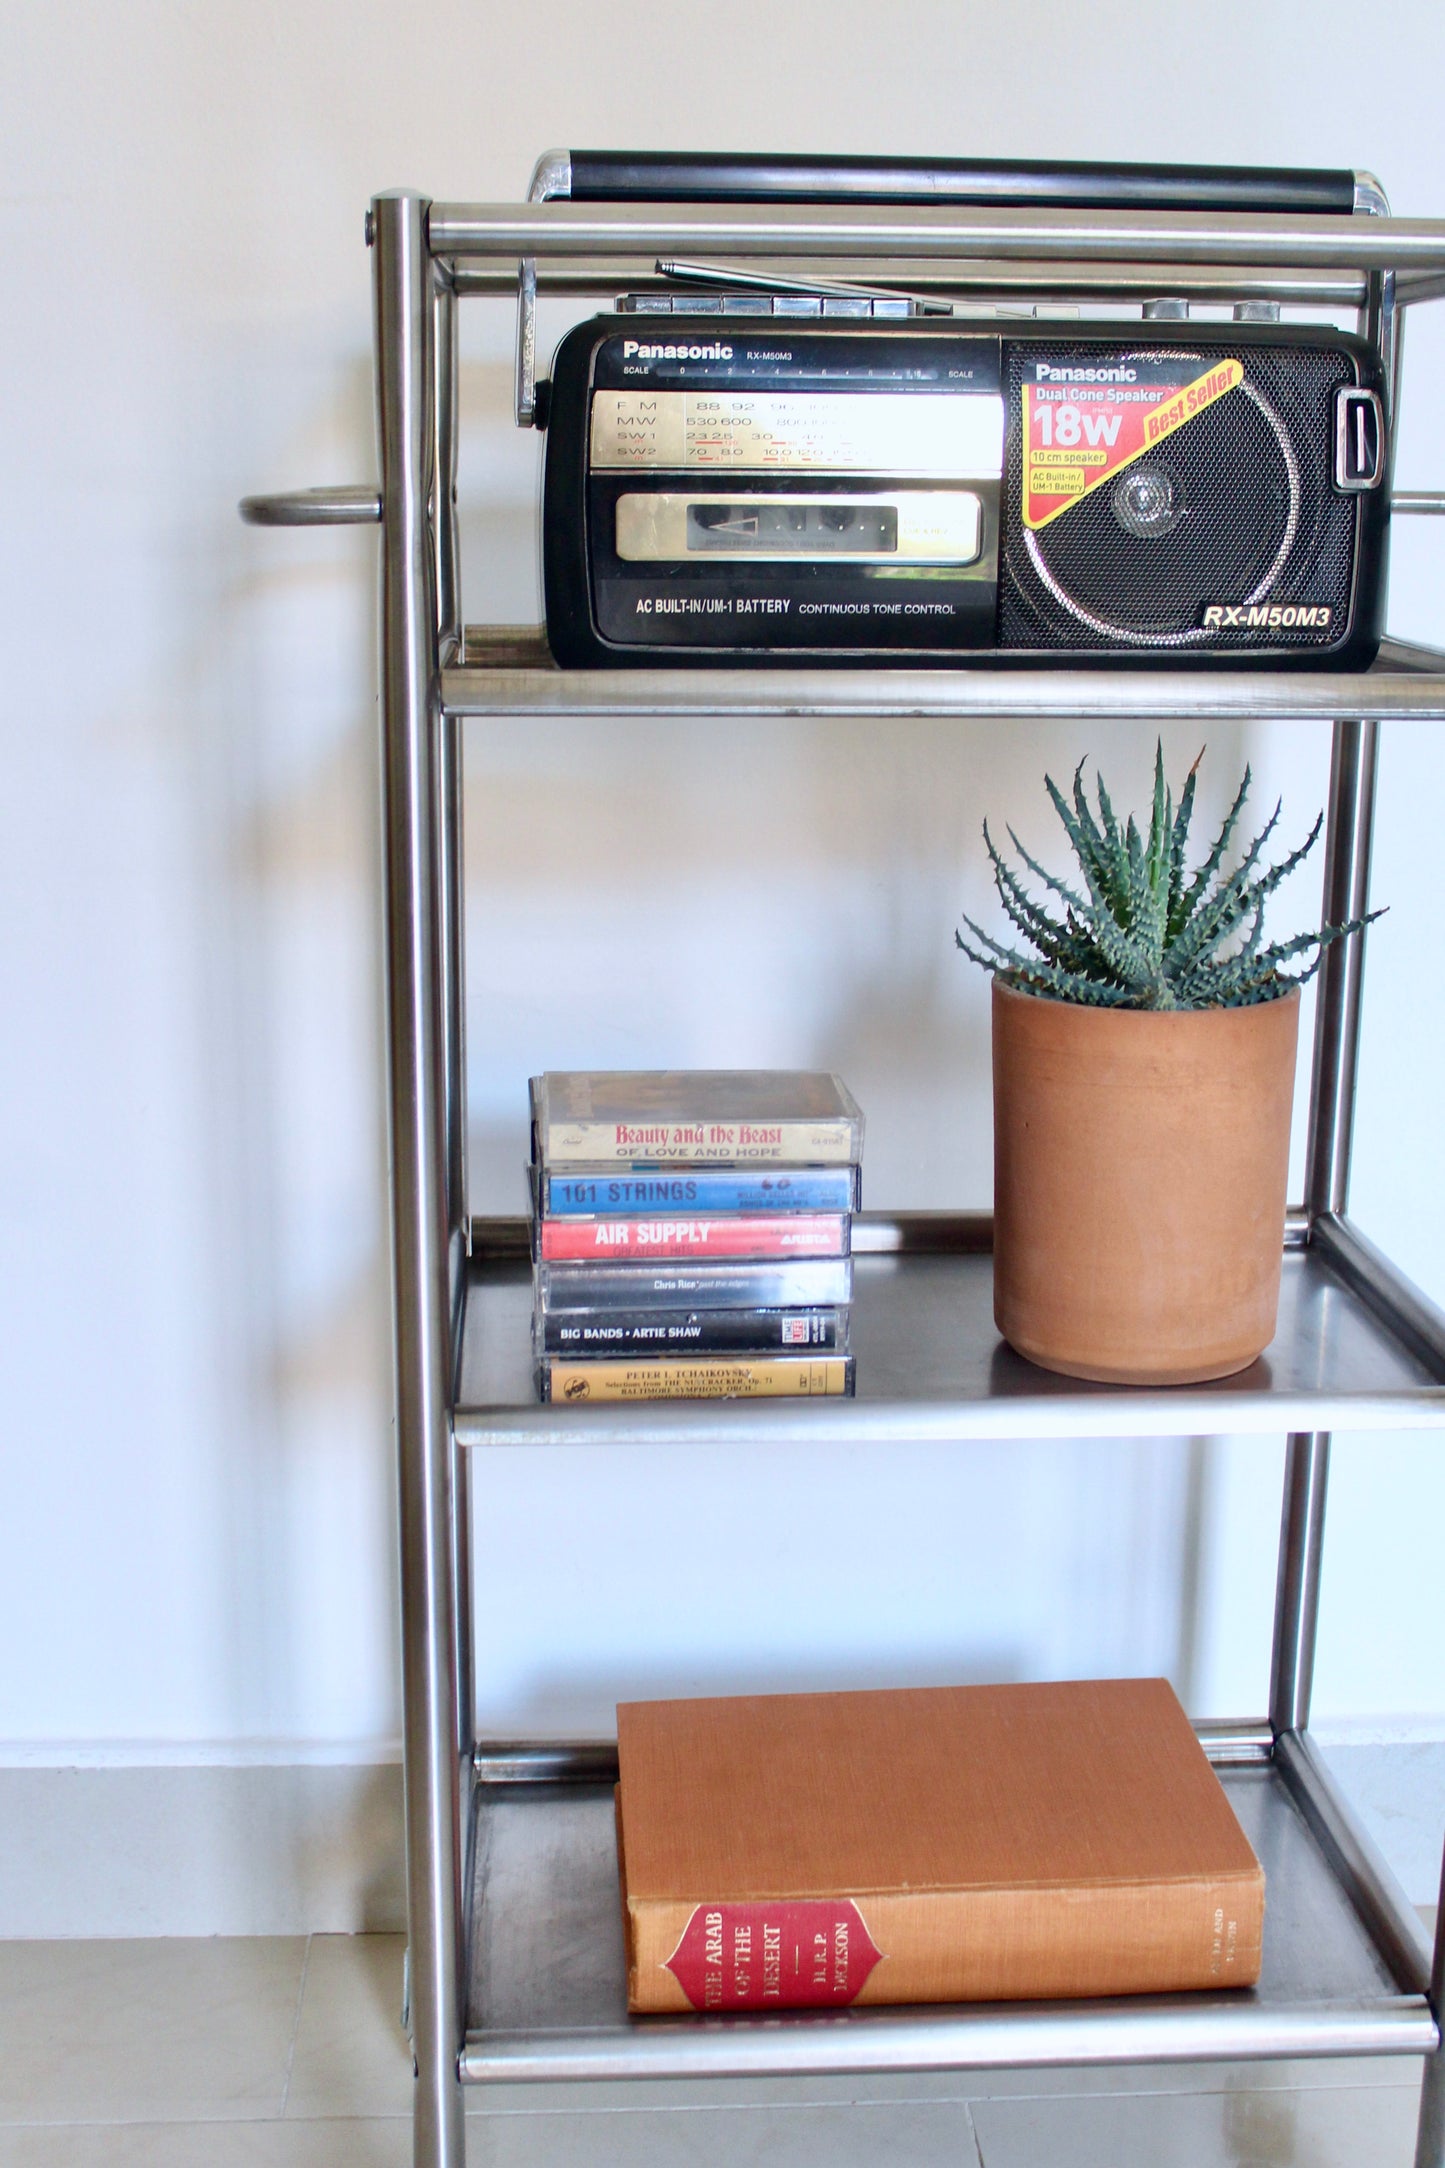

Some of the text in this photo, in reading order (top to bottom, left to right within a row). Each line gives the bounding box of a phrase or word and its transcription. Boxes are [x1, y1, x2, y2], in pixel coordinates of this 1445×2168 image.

[623, 340, 734, 360] Panasonic
[746, 351, 793, 361] RX-M50M3
[623, 366, 650, 375] SCALE
[948, 370, 974, 379] SCALE
[1036, 364, 1138, 382] Panasonic
[1036, 388, 1164, 404] Dual Cone Speaker
[696, 402, 720, 410] 88
[1147, 365, 1235, 442] Best Seller
[617, 417, 656, 425] MW
[686, 418, 717, 426] 530
[720, 418, 752, 426] 600
[1033, 452, 1105, 464] 10 cm speaker
[1032, 472, 1045, 481] AC
[1032, 482, 1083, 493] UM-1 Battery
[636, 599, 790, 614] AC BUILT-IN/UM-1 BATTERY
[798, 603, 956, 615] CONTINUOUS TONE CONTROL
[1203, 605, 1331, 627] RX-M50M3
[615, 1125, 782, 1147] Beauty and the Beast
[616, 1148, 781, 1157] OF LOVE AND HOPE
[561, 1181, 697, 1203] 101 STRINGS
[595, 1221, 711, 1244] AIR SUPPLY
[654, 1279, 676, 1290] Chris
[560, 1327, 701, 1339] BIG BANDS ARTIE SHAW
[626, 1372, 661, 1380] PETER
[676, 1369, 753, 1379] TCHAIKOVSKY
[621, 1386, 671, 1394] BALTIMORE
[675, 1384, 723, 1393] SYMPHONY
[664, 1379, 681, 1387] THE
[705, 1911, 723, 1965] ARAB
[734, 1925, 751, 1996] OF THE
[763, 1923, 781, 1997] DESERT
[833, 1922, 849, 1992] DICKSON
